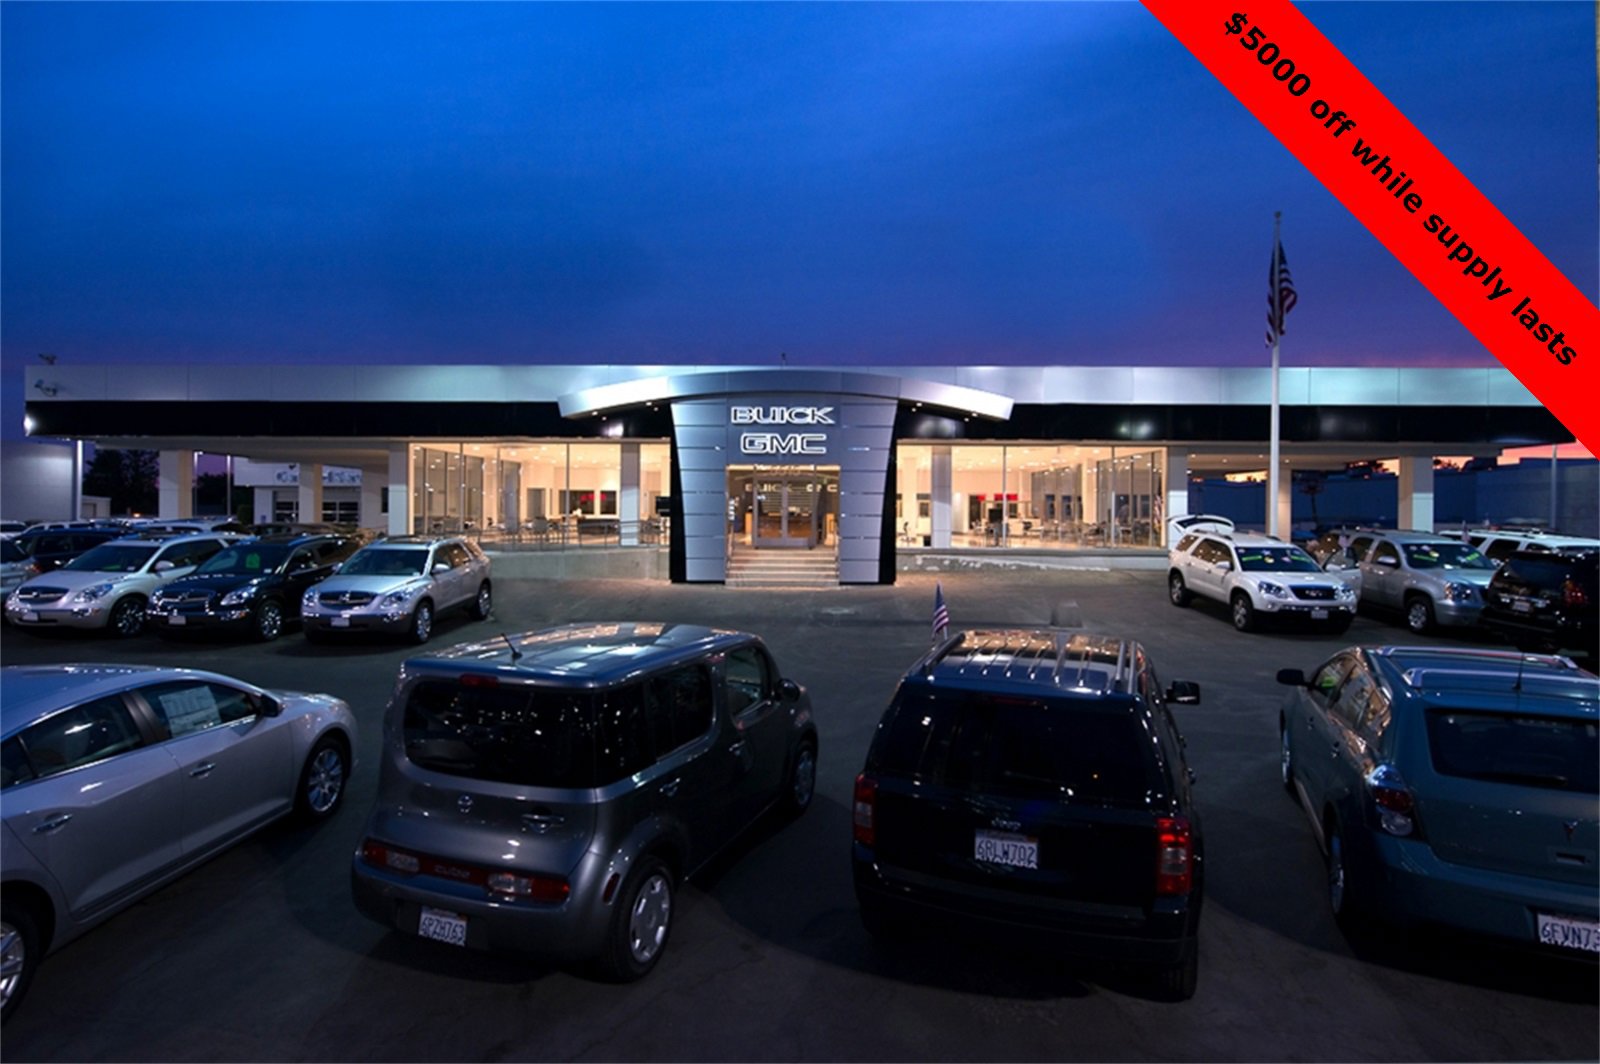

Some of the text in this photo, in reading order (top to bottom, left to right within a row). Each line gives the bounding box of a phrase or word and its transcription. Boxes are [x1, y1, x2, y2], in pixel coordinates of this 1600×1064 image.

[731, 406, 836, 424] BUICK
[740, 433, 827, 454] GMC
[976, 839, 1036, 865] 6RLW702
